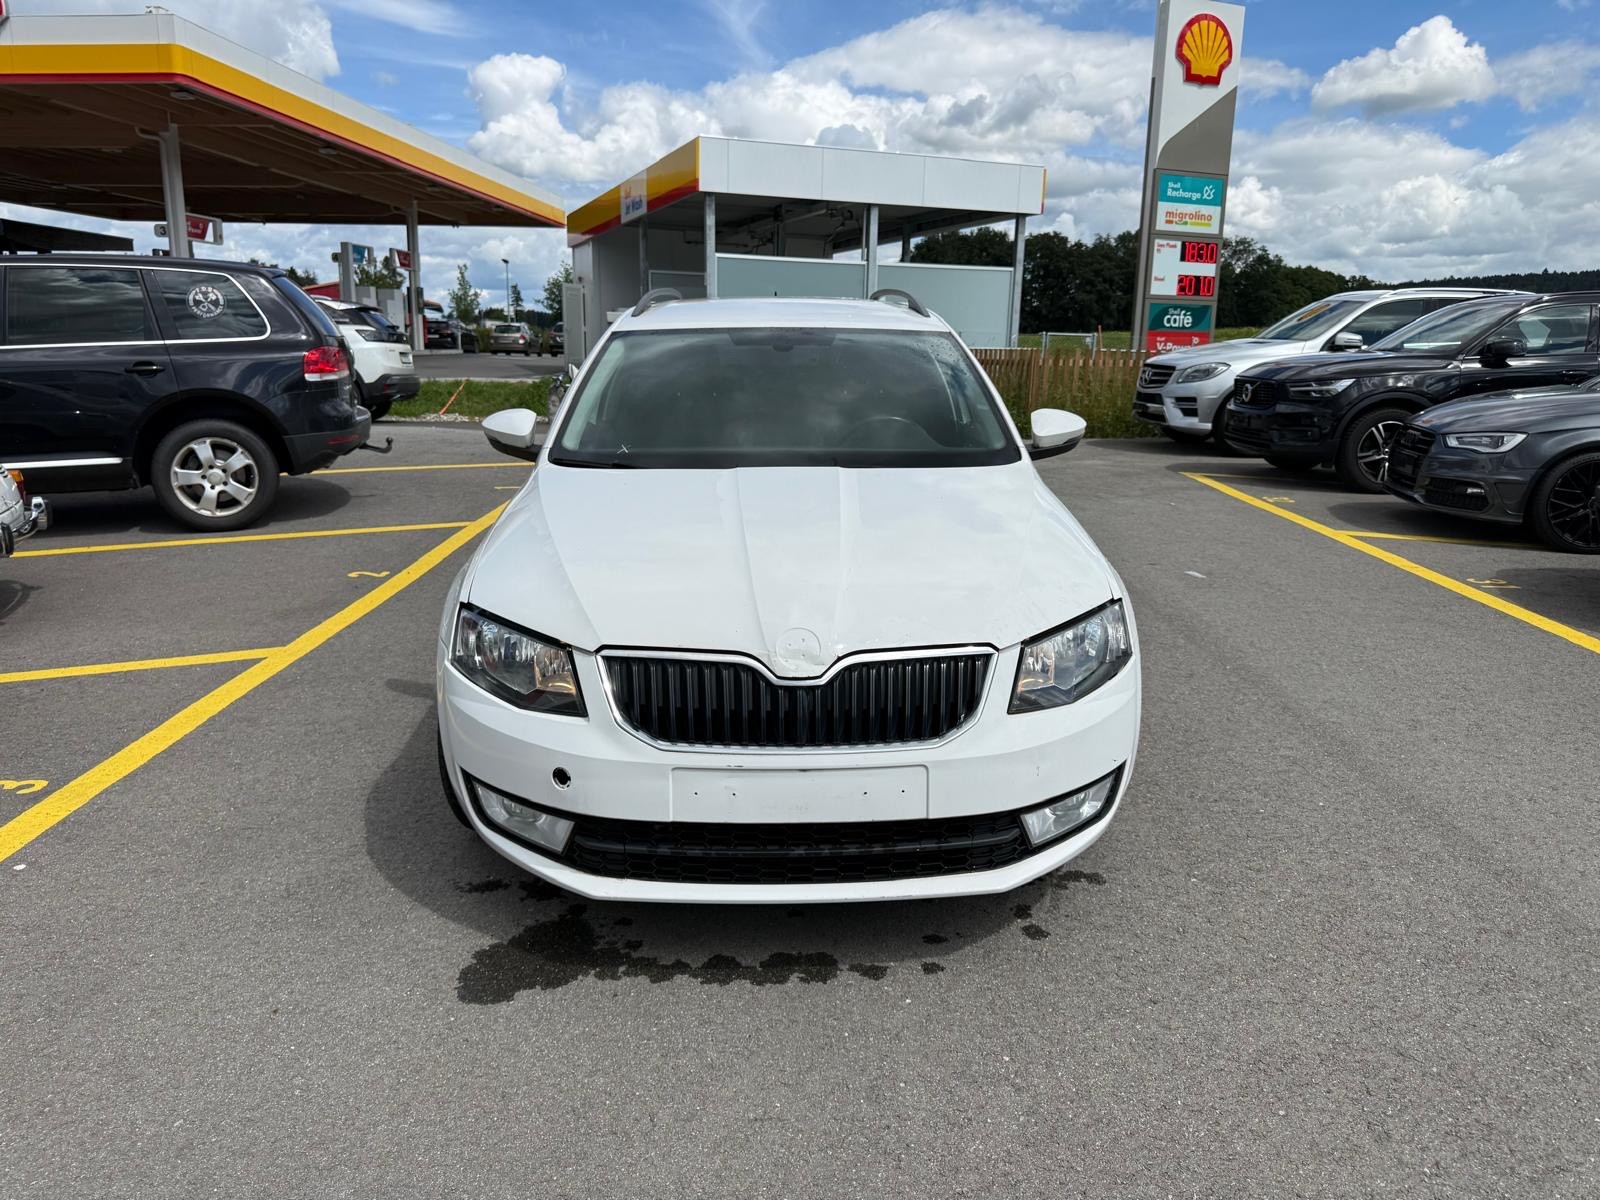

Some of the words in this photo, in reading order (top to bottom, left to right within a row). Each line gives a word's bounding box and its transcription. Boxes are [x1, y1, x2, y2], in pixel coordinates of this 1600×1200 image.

[1167, 188, 1202, 200] Recharge
[1165, 209, 1213, 222] migrolino
[160, 226, 167, 236] 3
[1163, 310, 1192, 327] café
